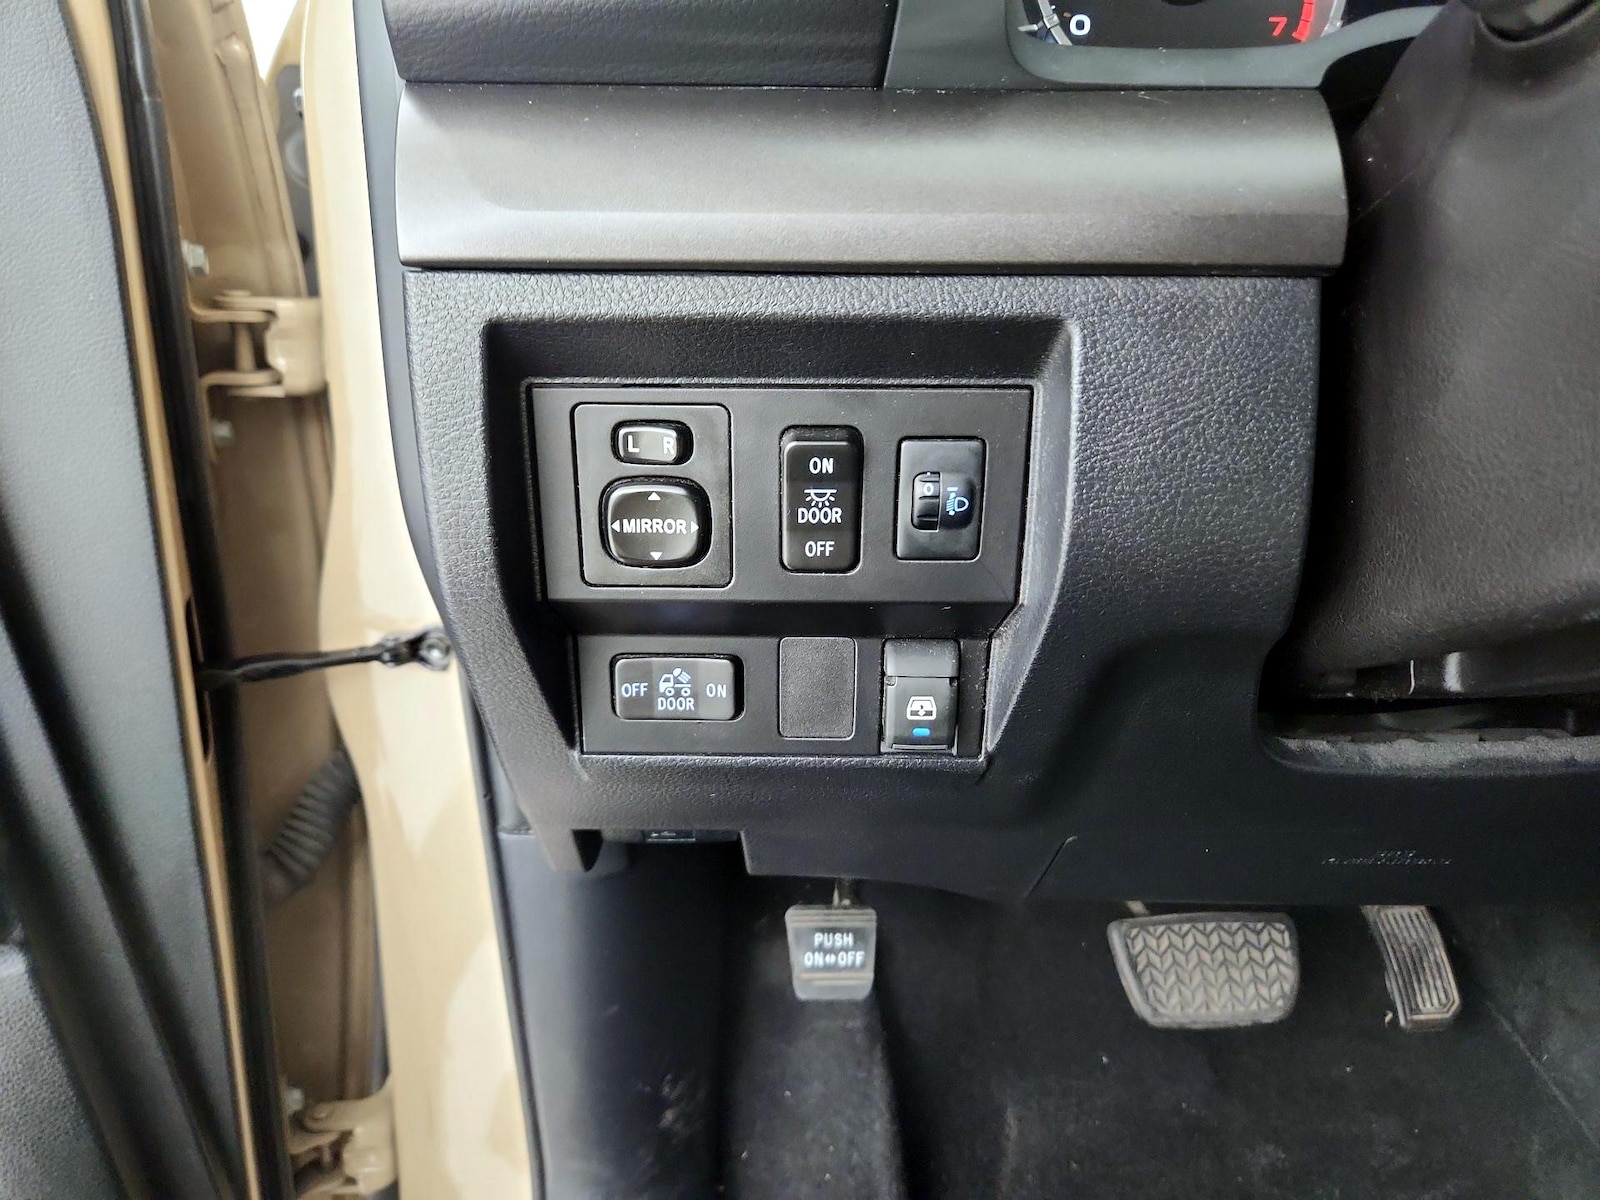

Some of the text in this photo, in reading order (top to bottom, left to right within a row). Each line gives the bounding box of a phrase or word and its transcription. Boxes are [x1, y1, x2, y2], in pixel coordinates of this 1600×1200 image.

[1069, 13, 1091, 36] 0
[1268, 16, 1288, 37] 7
[627, 434, 640, 453] L
[663, 437, 675, 455] R
[808, 456, 834, 475] ON
[923, 482, 934, 496] 0
[797, 507, 842, 524] DOOR
[622, 518, 687, 535] MIRROR
[804, 540, 835, 557] OFF
[621, 682, 649, 699] OFF
[706, 683, 727, 699] ON
[657, 697, 695, 711] DOOR
[814, 932, 854, 949] PUSH
[804, 950, 865, 969] ON OFF
